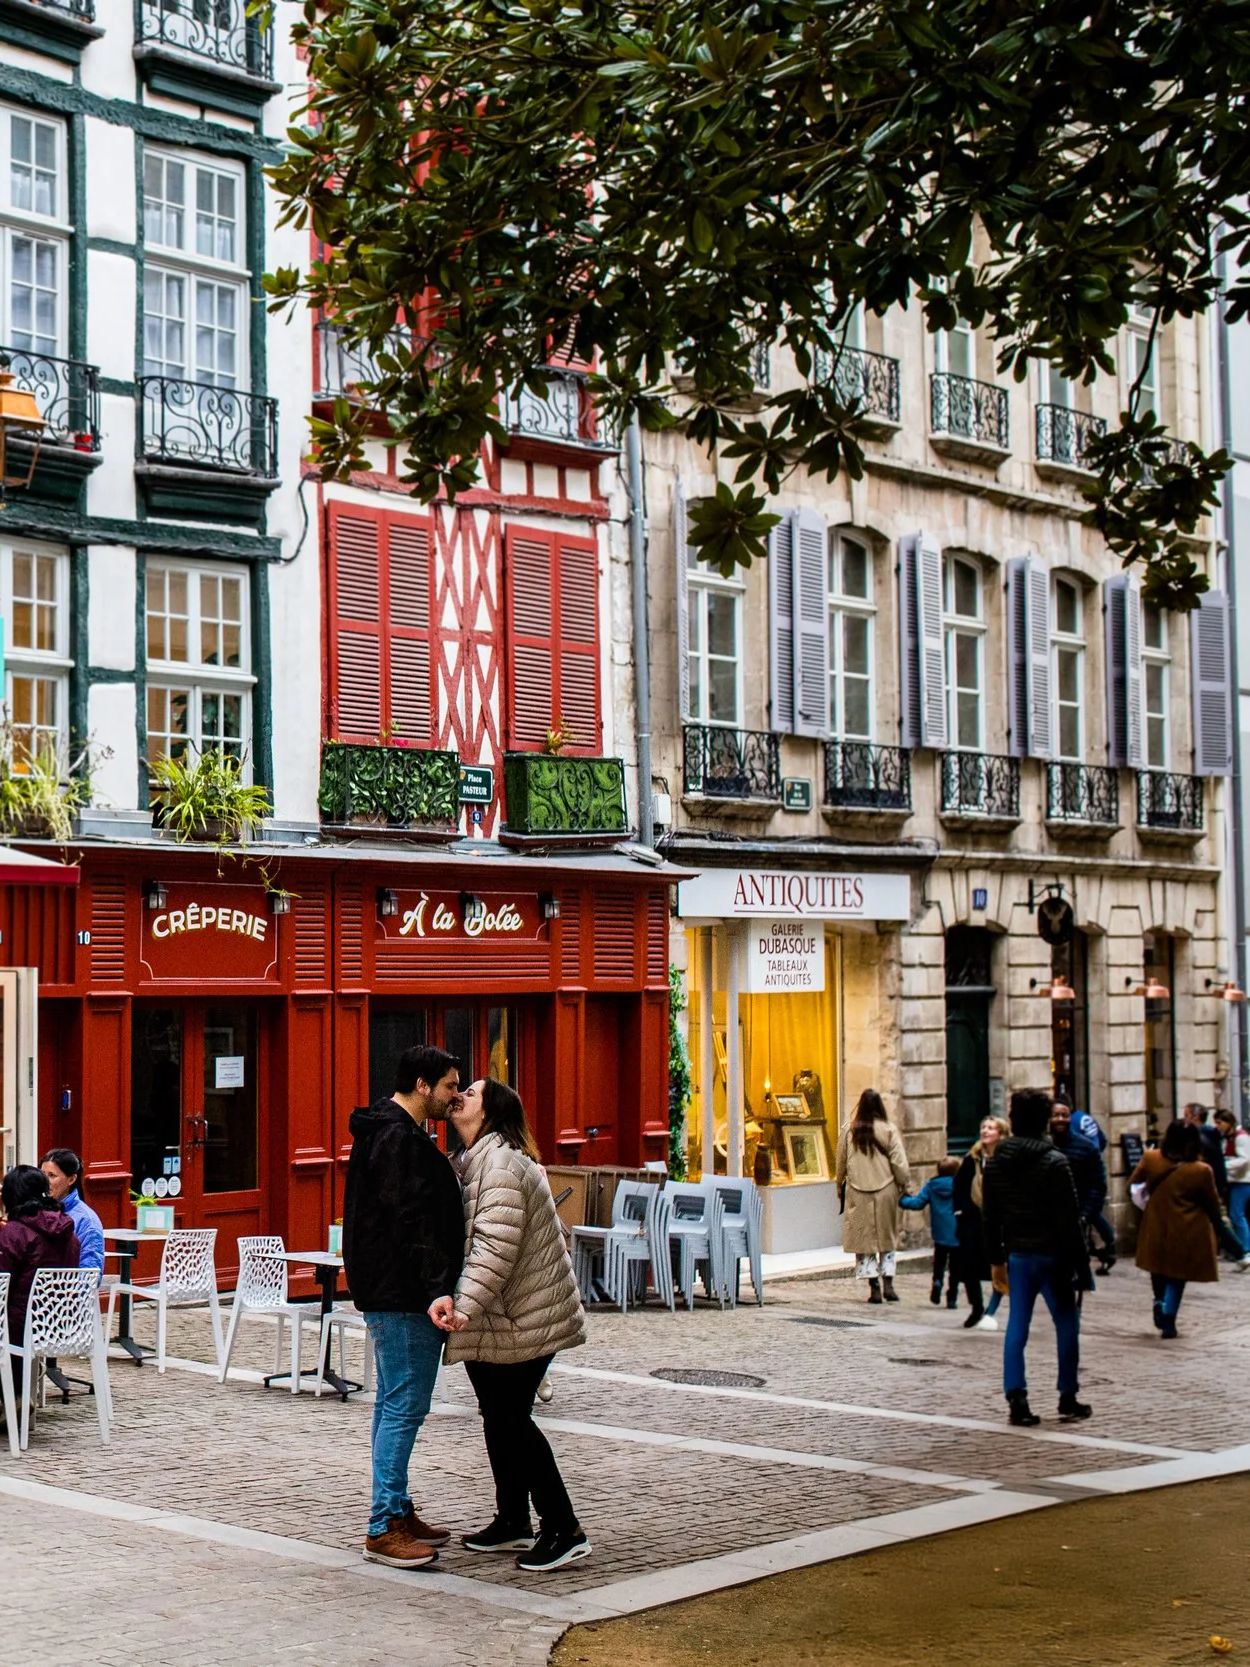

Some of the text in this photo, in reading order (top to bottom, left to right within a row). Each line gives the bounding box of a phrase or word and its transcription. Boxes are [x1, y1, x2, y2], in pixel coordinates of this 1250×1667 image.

[467, 774, 482, 783] Place
[463, 785, 487, 796] PASTEUR
[734, 873, 864, 913] ANTIQUITES
[152, 902, 268, 942] CRÊPERIE
[432, 902, 456, 930] la
[464, 901, 524, 937] Bolée
[771, 923, 804, 936] GALERIE
[77, 930, 90, 945] 10
[759, 938, 816, 956] DUBASQUE
[768, 960, 808, 971] TABLEAUX
[765, 974, 812, 986] ANTIQUITES
